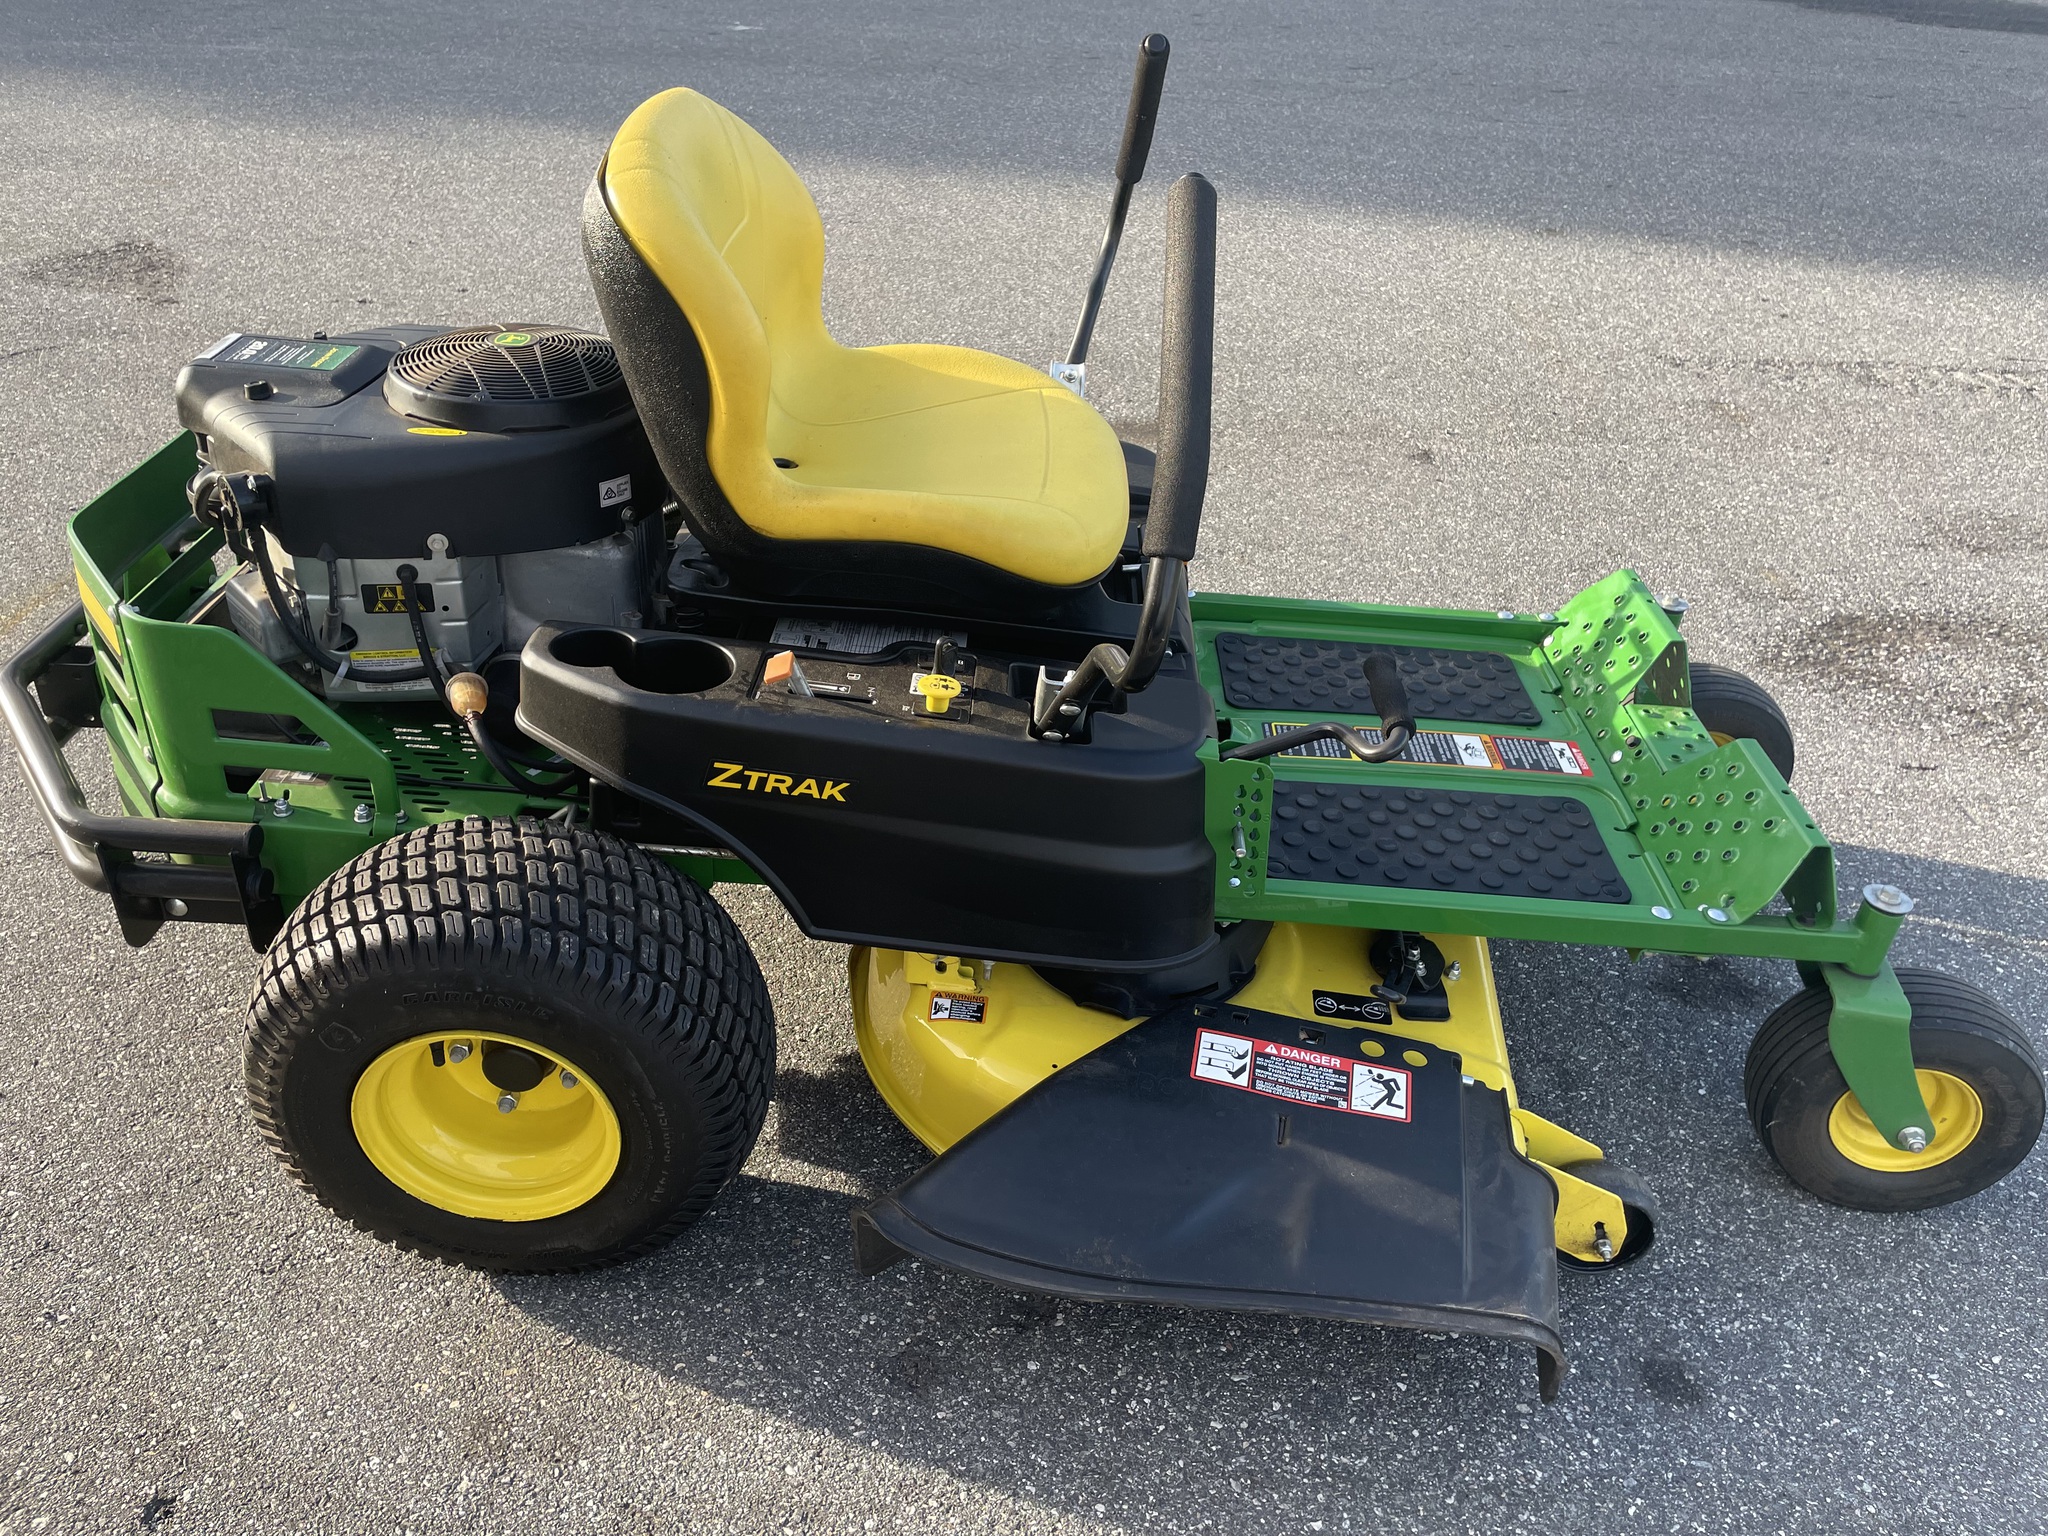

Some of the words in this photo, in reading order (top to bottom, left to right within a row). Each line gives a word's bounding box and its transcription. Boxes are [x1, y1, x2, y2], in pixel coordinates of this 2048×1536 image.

[707, 762, 850, 802] ZTRAK
[945, 992, 985, 1002] WARNING
[1271, 1056, 1307, 1068] ROTATING
[1309, 1065, 1333, 1073] BLADE
[1281, 1047, 1341, 1068] DANGER
[1267, 1068, 1299, 1078] THROWN
[1301, 1075, 1335, 1086] OBJECTS
